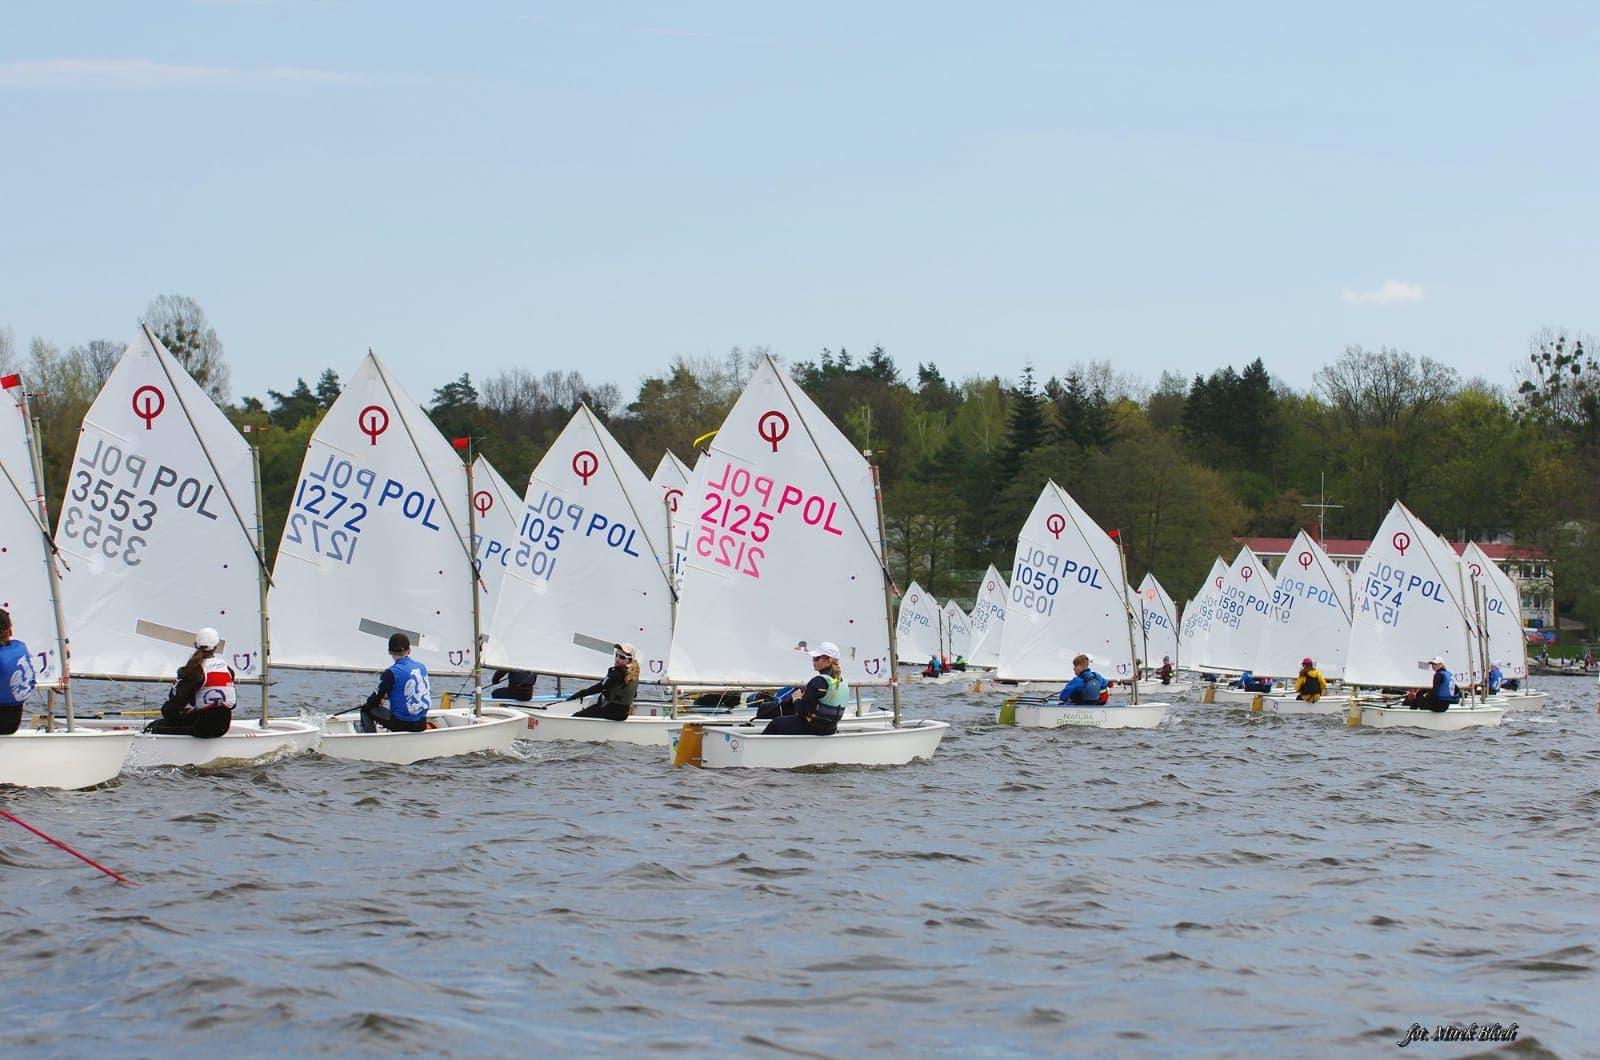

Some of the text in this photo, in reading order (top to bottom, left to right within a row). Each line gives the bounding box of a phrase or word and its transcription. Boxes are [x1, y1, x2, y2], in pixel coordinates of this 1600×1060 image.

[72, 470, 157, 531] 3553
[149, 465, 220, 520] POL
[296, 479, 367, 533] 1272
[378, 479, 440, 531] POL
[701, 493, 774, 542] 2125
[777, 484, 843, 536] POL
[520, 513, 564, 551] 105
[586, 513, 639, 558] POL
[1016, 563, 1058, 595] 1050
[1062, 560, 1102, 590] POL
[1407, 575, 1444, 603] POL
[1219, 595, 1244, 616] 1580
[1272, 590, 1294, 609] 971
[1307, 586, 1336, 607] POL
[1365, 577, 1402, 608] 1574
[1485, 597, 1505, 615] OL
[914, 613, 930, 627] POL
[1149, 612, 1168, 629] POL
